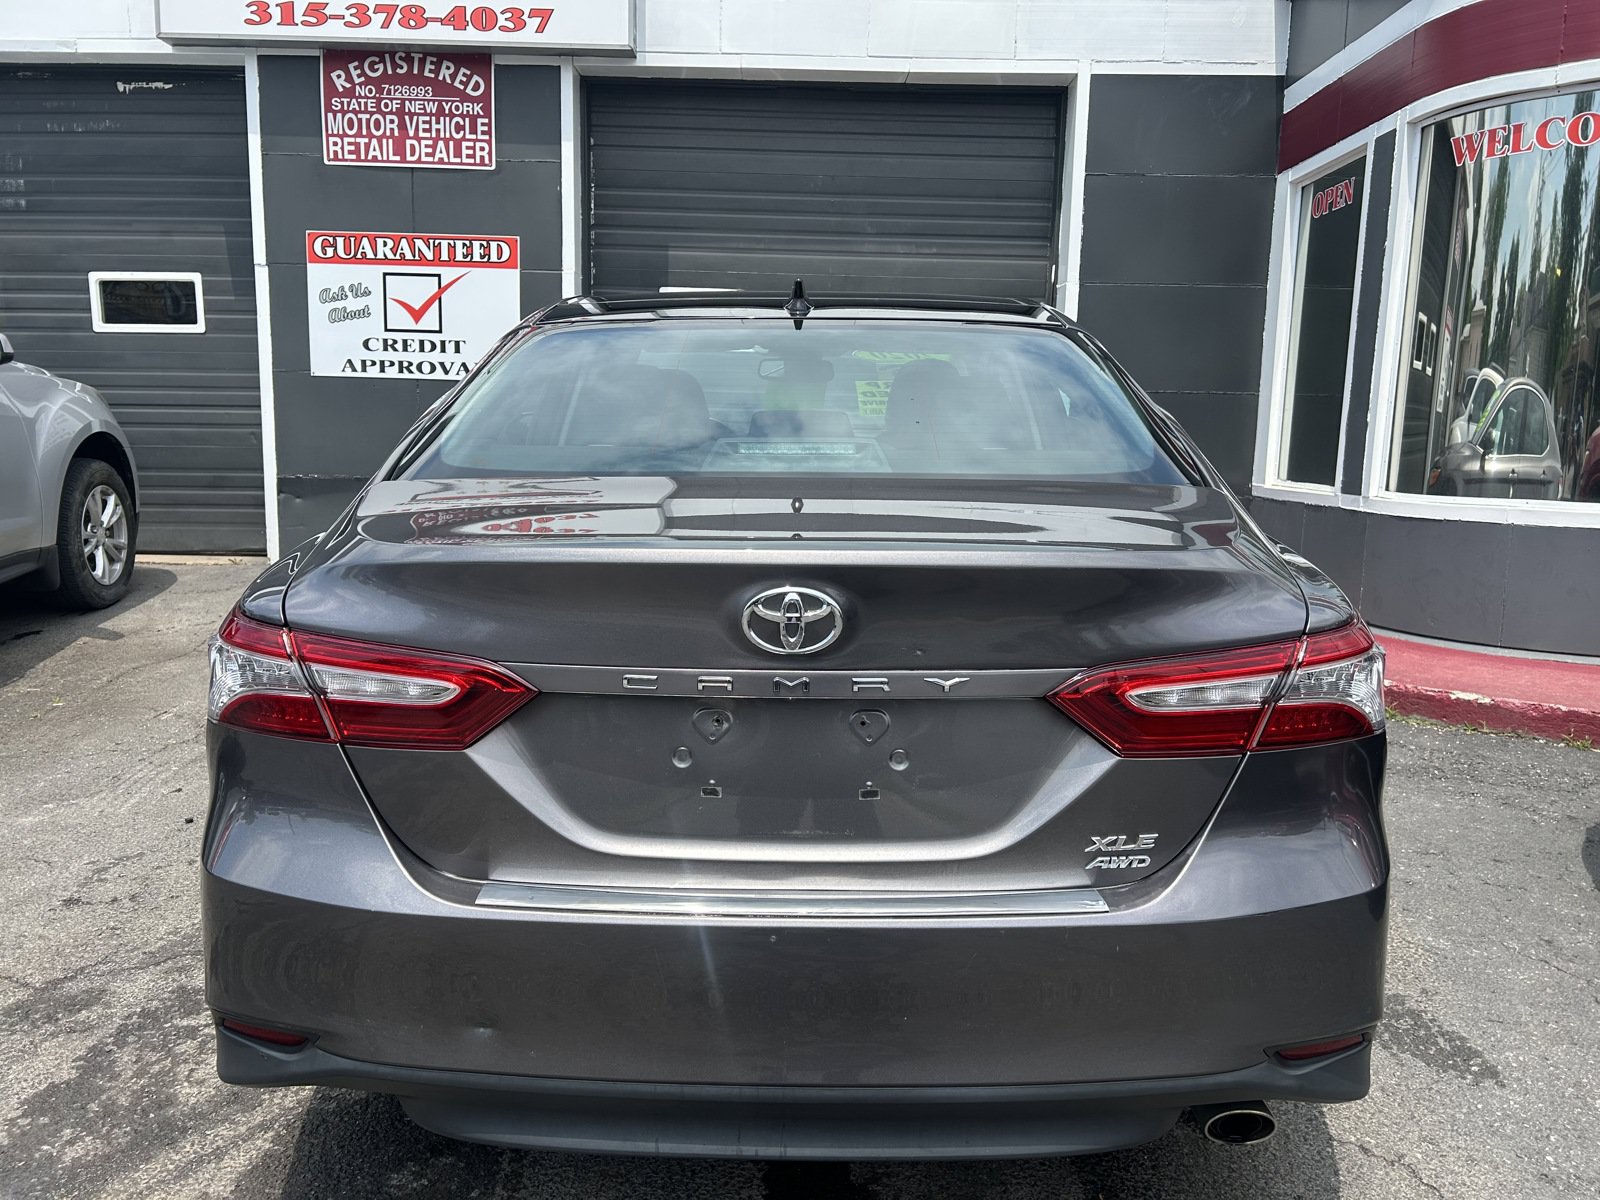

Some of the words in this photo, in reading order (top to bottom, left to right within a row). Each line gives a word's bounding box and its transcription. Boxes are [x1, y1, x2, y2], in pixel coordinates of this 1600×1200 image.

[243, 1, 554, 33] 315-378-4037
[330, 51, 485, 97] REGISTERED
[355, 85, 380, 97] NO.
[381, 84, 433, 97] 7126993
[331, 98, 377, 112] STATE
[380, 100, 400, 112] OF
[405, 101, 439, 114] NEW
[442, 102, 484, 115] YORK
[327, 112, 399, 137] MOTOR
[404, 115, 490, 140] VEHICLE
[328, 137, 401, 162] RETAIL
[405, 139, 490, 165] DEALER
[1311, 177, 1356, 219] OPEN
[313, 235, 511, 263] GUARANTEED
[319, 286, 348, 304] Ask
[348, 283, 372, 299] Us
[328, 304, 372, 324] About
[362, 337, 467, 355] CREDIT
[341, 358, 479, 376] APPROVA
[622, 674, 971, 692] CAMRY
[1084, 833, 1159, 852] XLE
[1085, 855, 1151, 869] AWD
